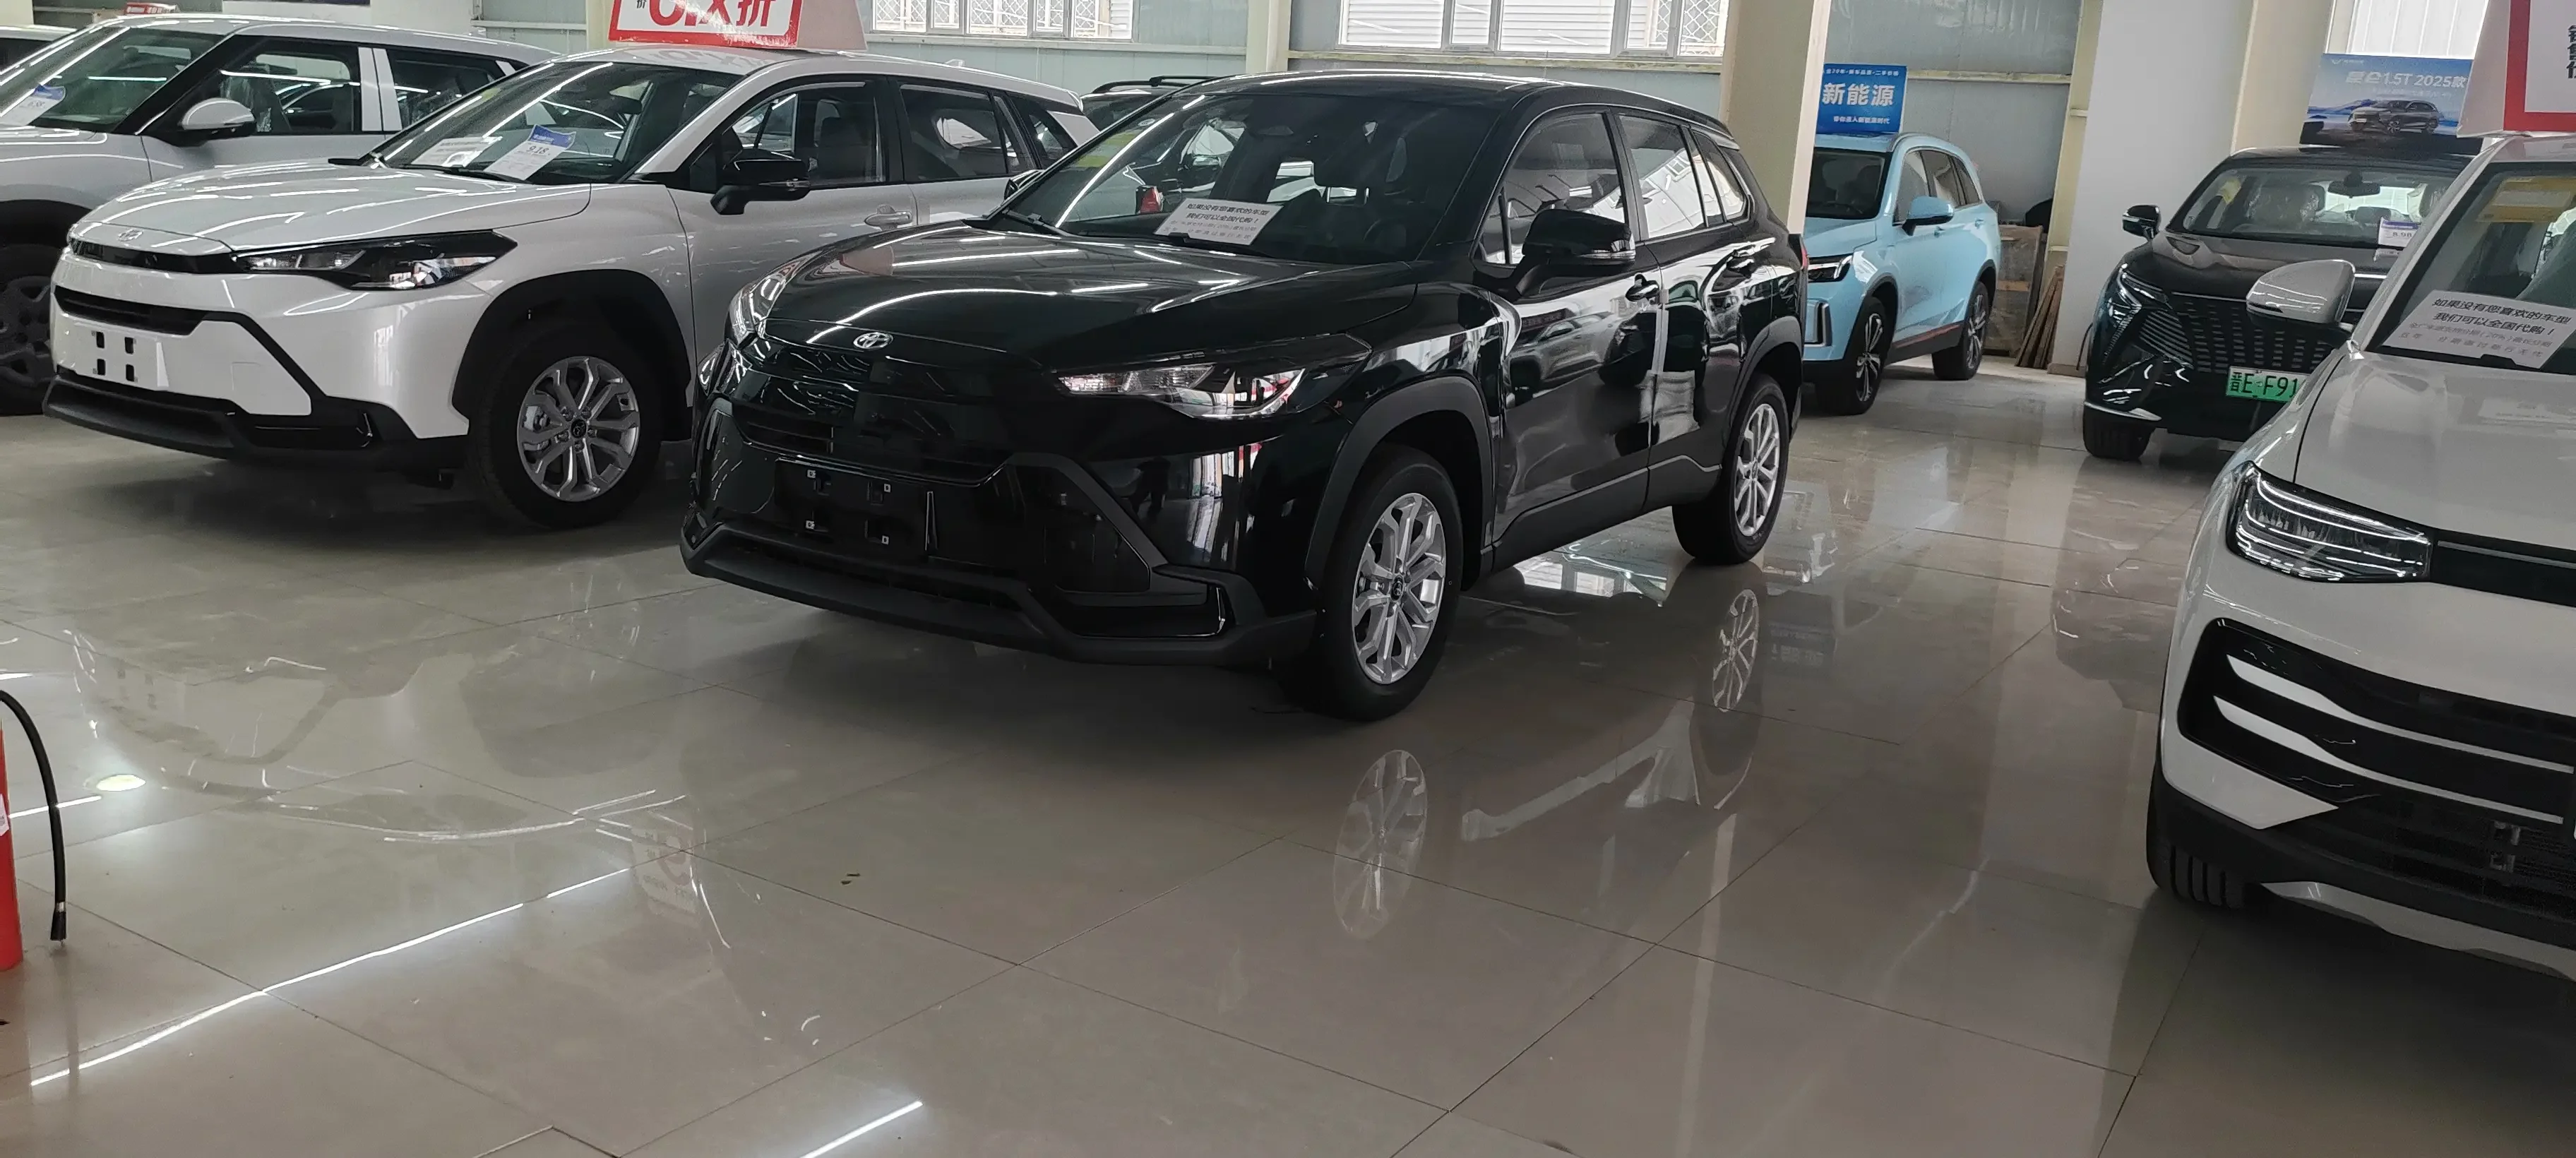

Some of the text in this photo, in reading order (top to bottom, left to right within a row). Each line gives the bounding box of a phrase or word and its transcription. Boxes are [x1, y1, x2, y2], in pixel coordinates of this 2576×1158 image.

[1822, 83, 1895, 107] 新能源
[2432, 298, 2572, 324] 如果没有您喜欢的车型
[2433, 312, 2554, 335] 我们可以全国代购！
